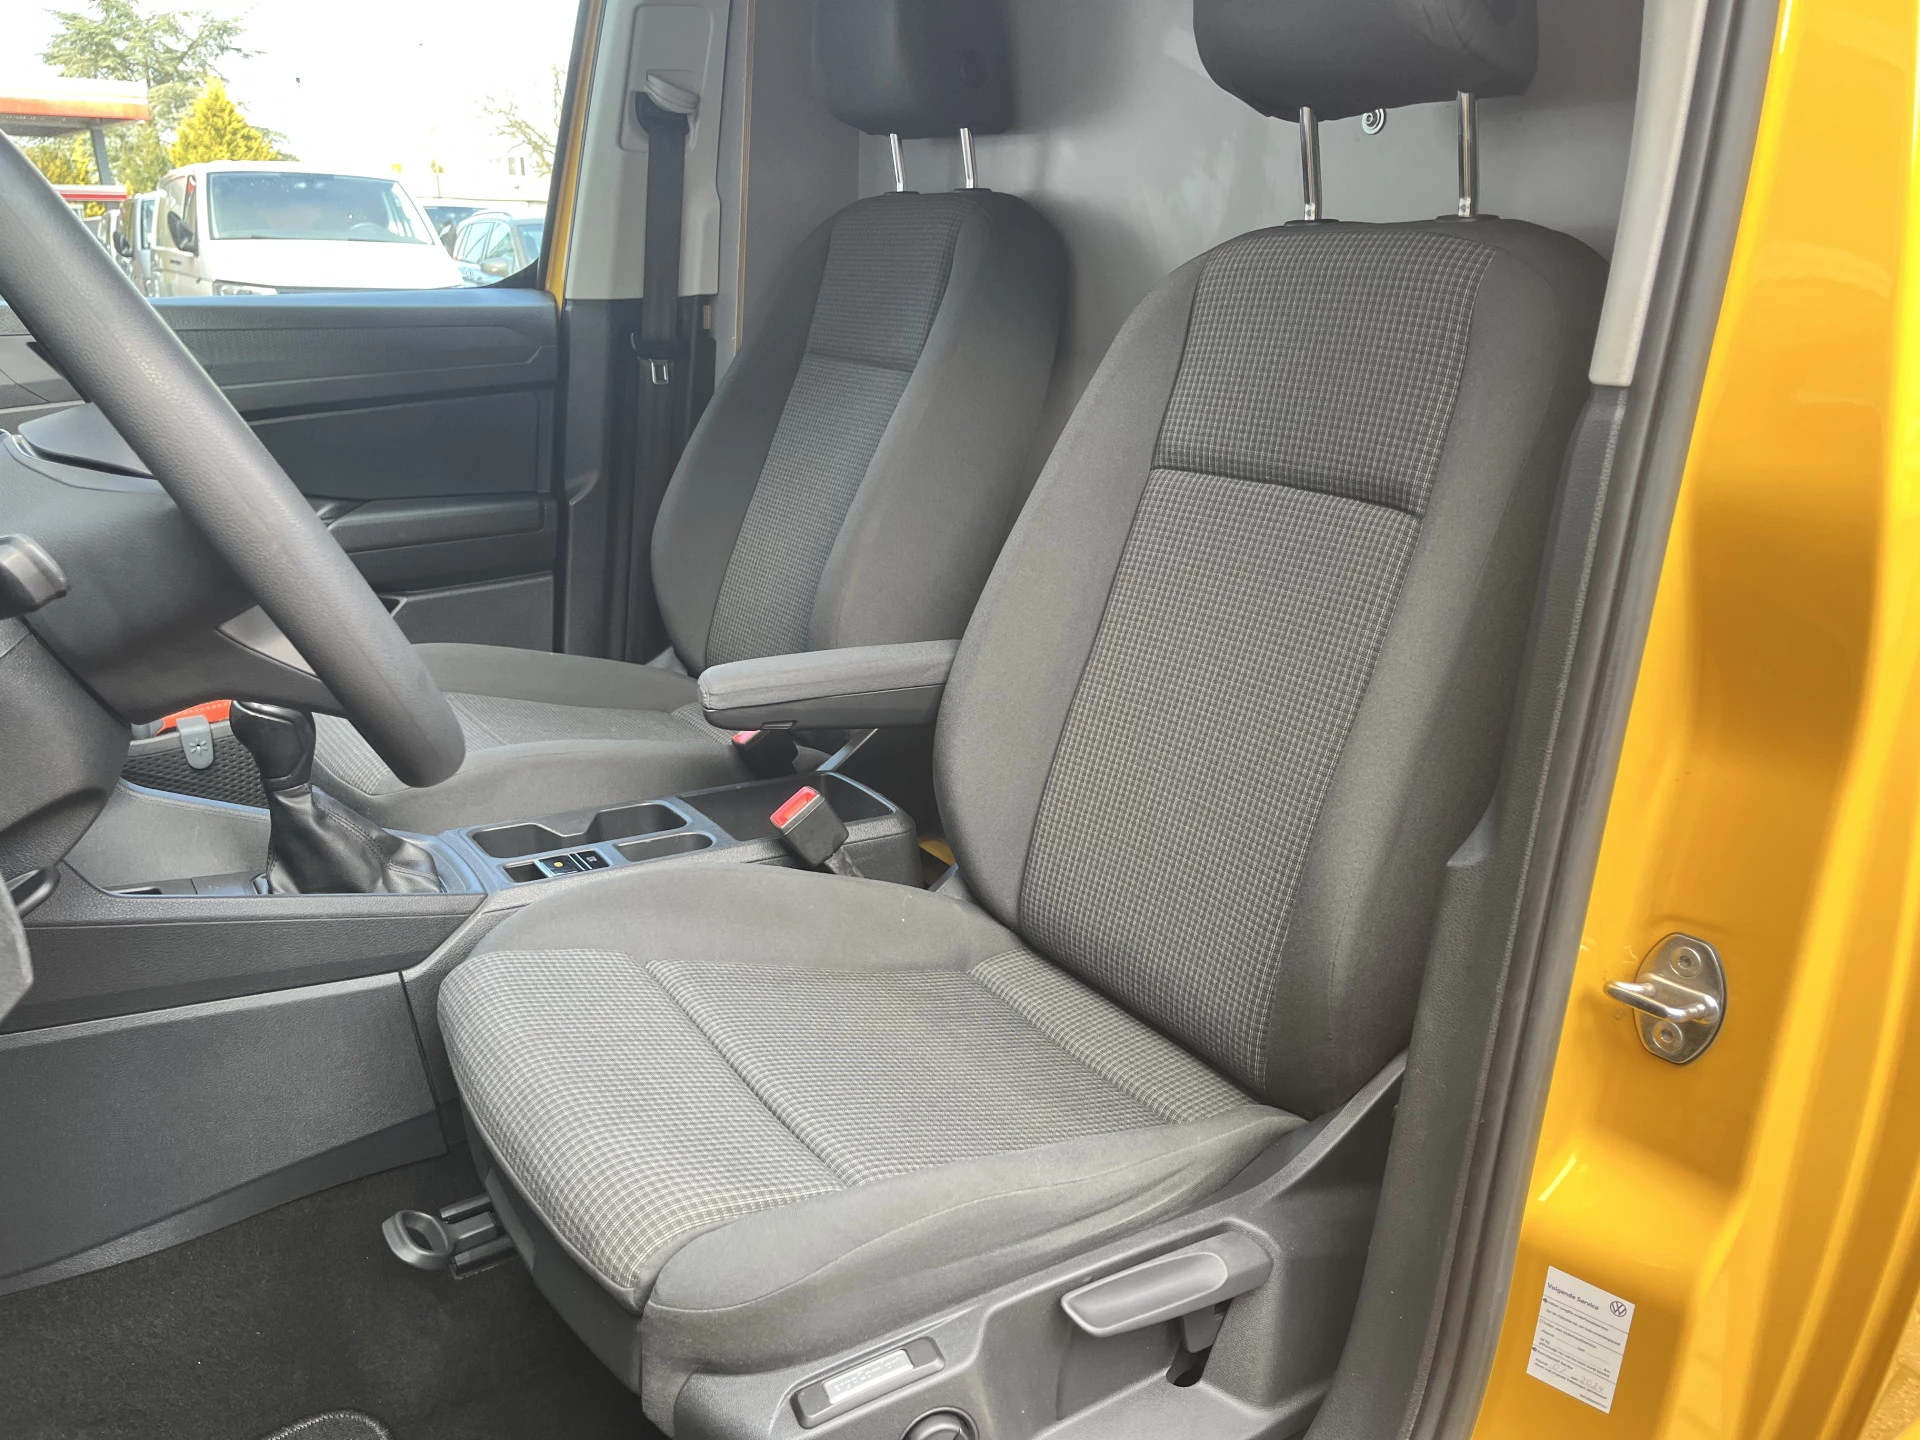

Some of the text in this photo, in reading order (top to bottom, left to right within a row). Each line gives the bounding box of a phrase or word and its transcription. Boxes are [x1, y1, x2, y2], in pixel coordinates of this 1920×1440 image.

[1547, 1282, 1599, 1311] Volgende Service
[1609, 1300, 1627, 1317] VW
